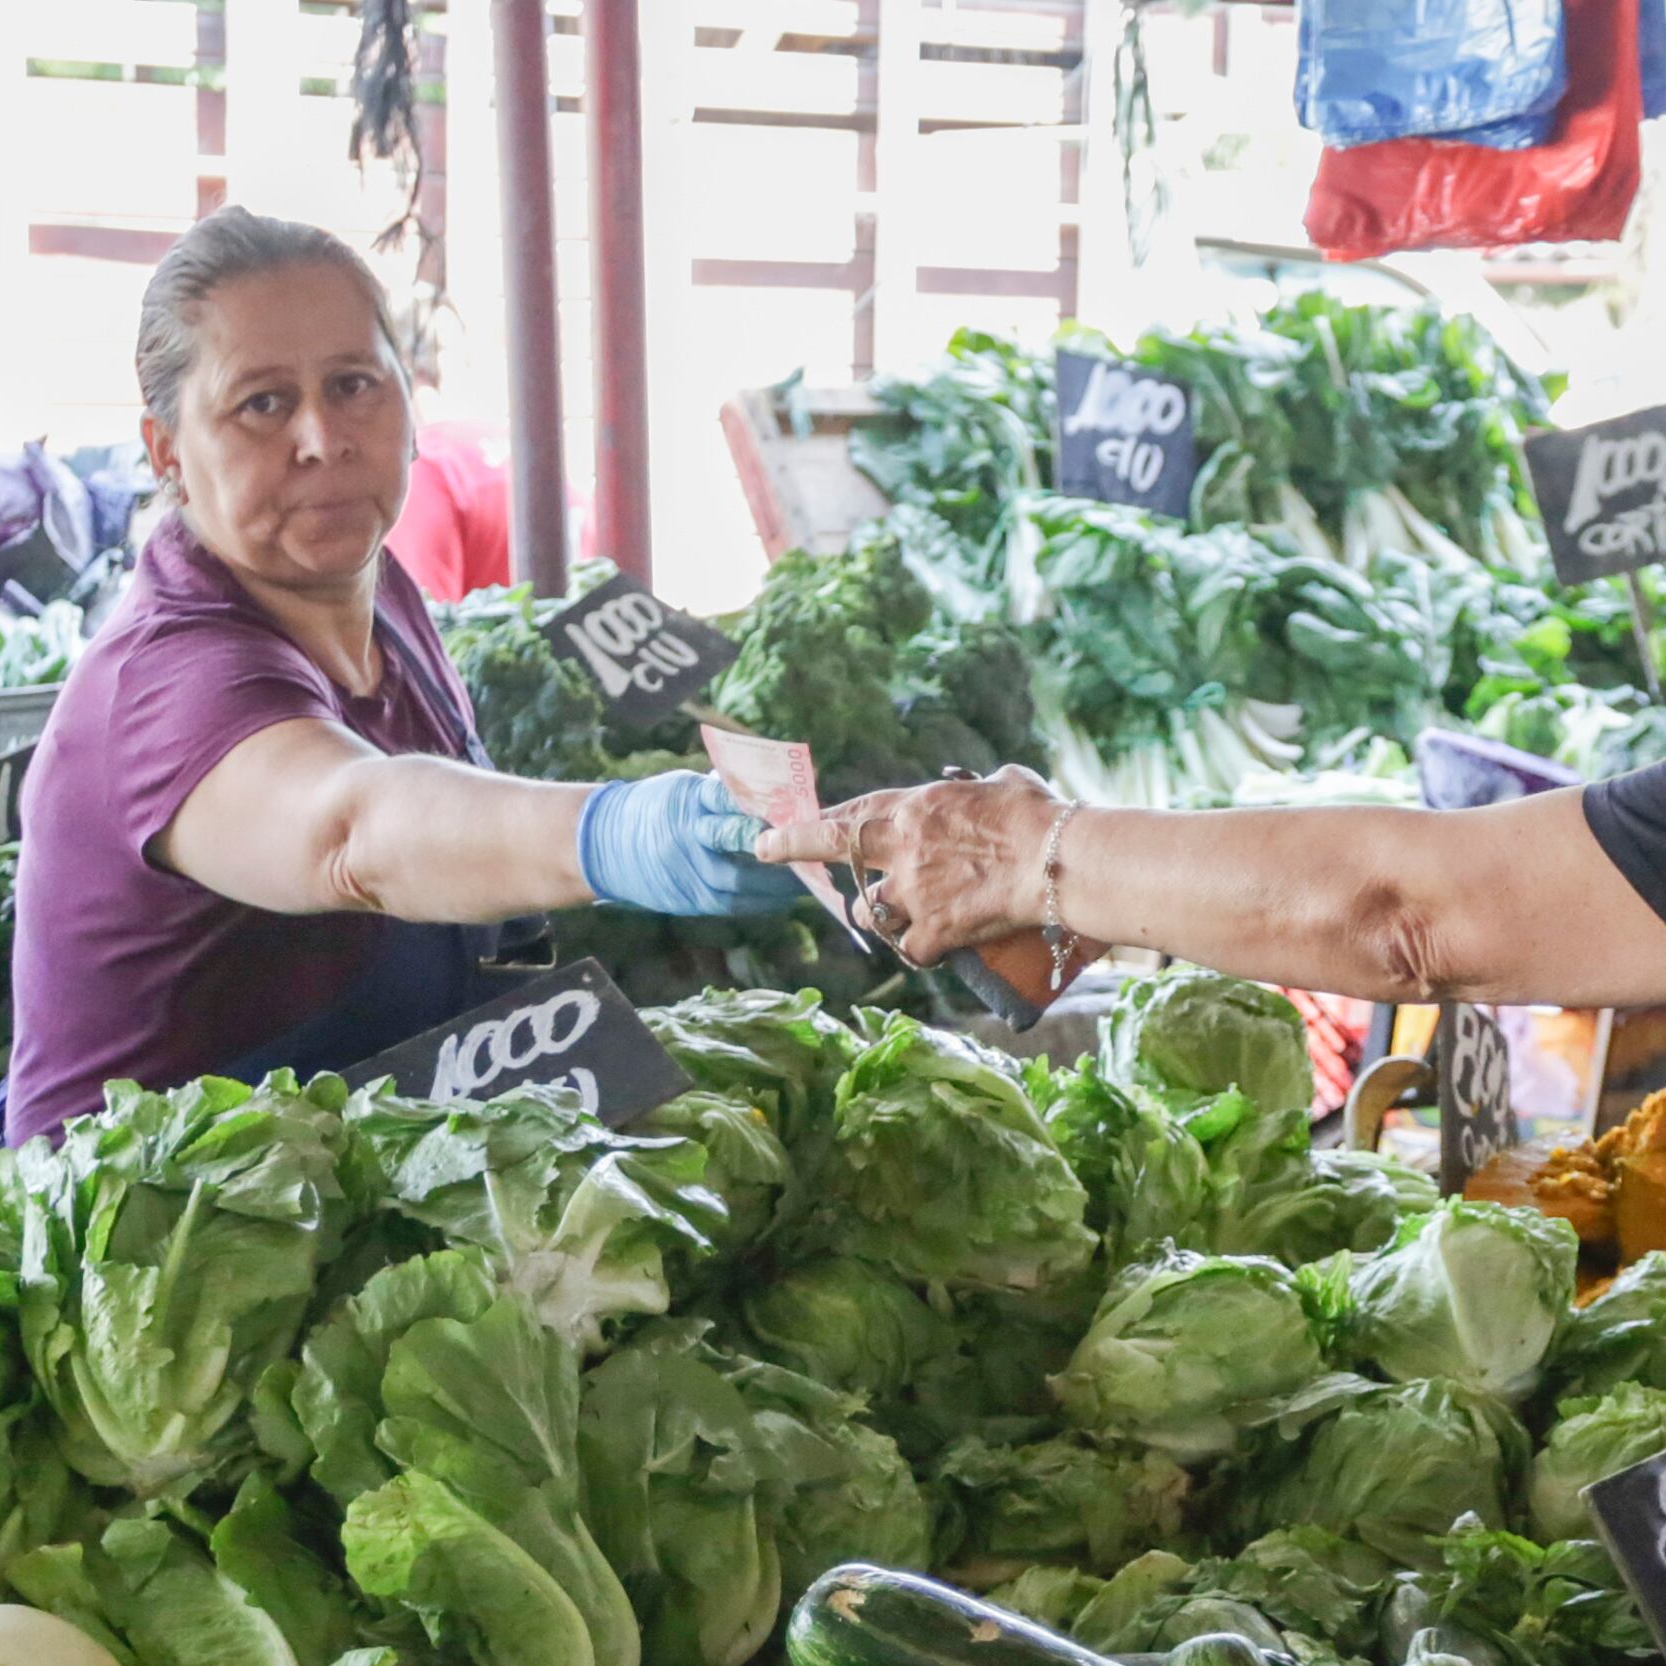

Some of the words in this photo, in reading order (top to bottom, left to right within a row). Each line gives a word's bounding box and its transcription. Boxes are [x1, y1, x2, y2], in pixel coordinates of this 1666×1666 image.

[1062, 361, 1186, 436] 1000
[564, 592, 664, 698] 1000
[787, 748, 809, 798] 5000
[429, 989, 602, 1103] 1000
